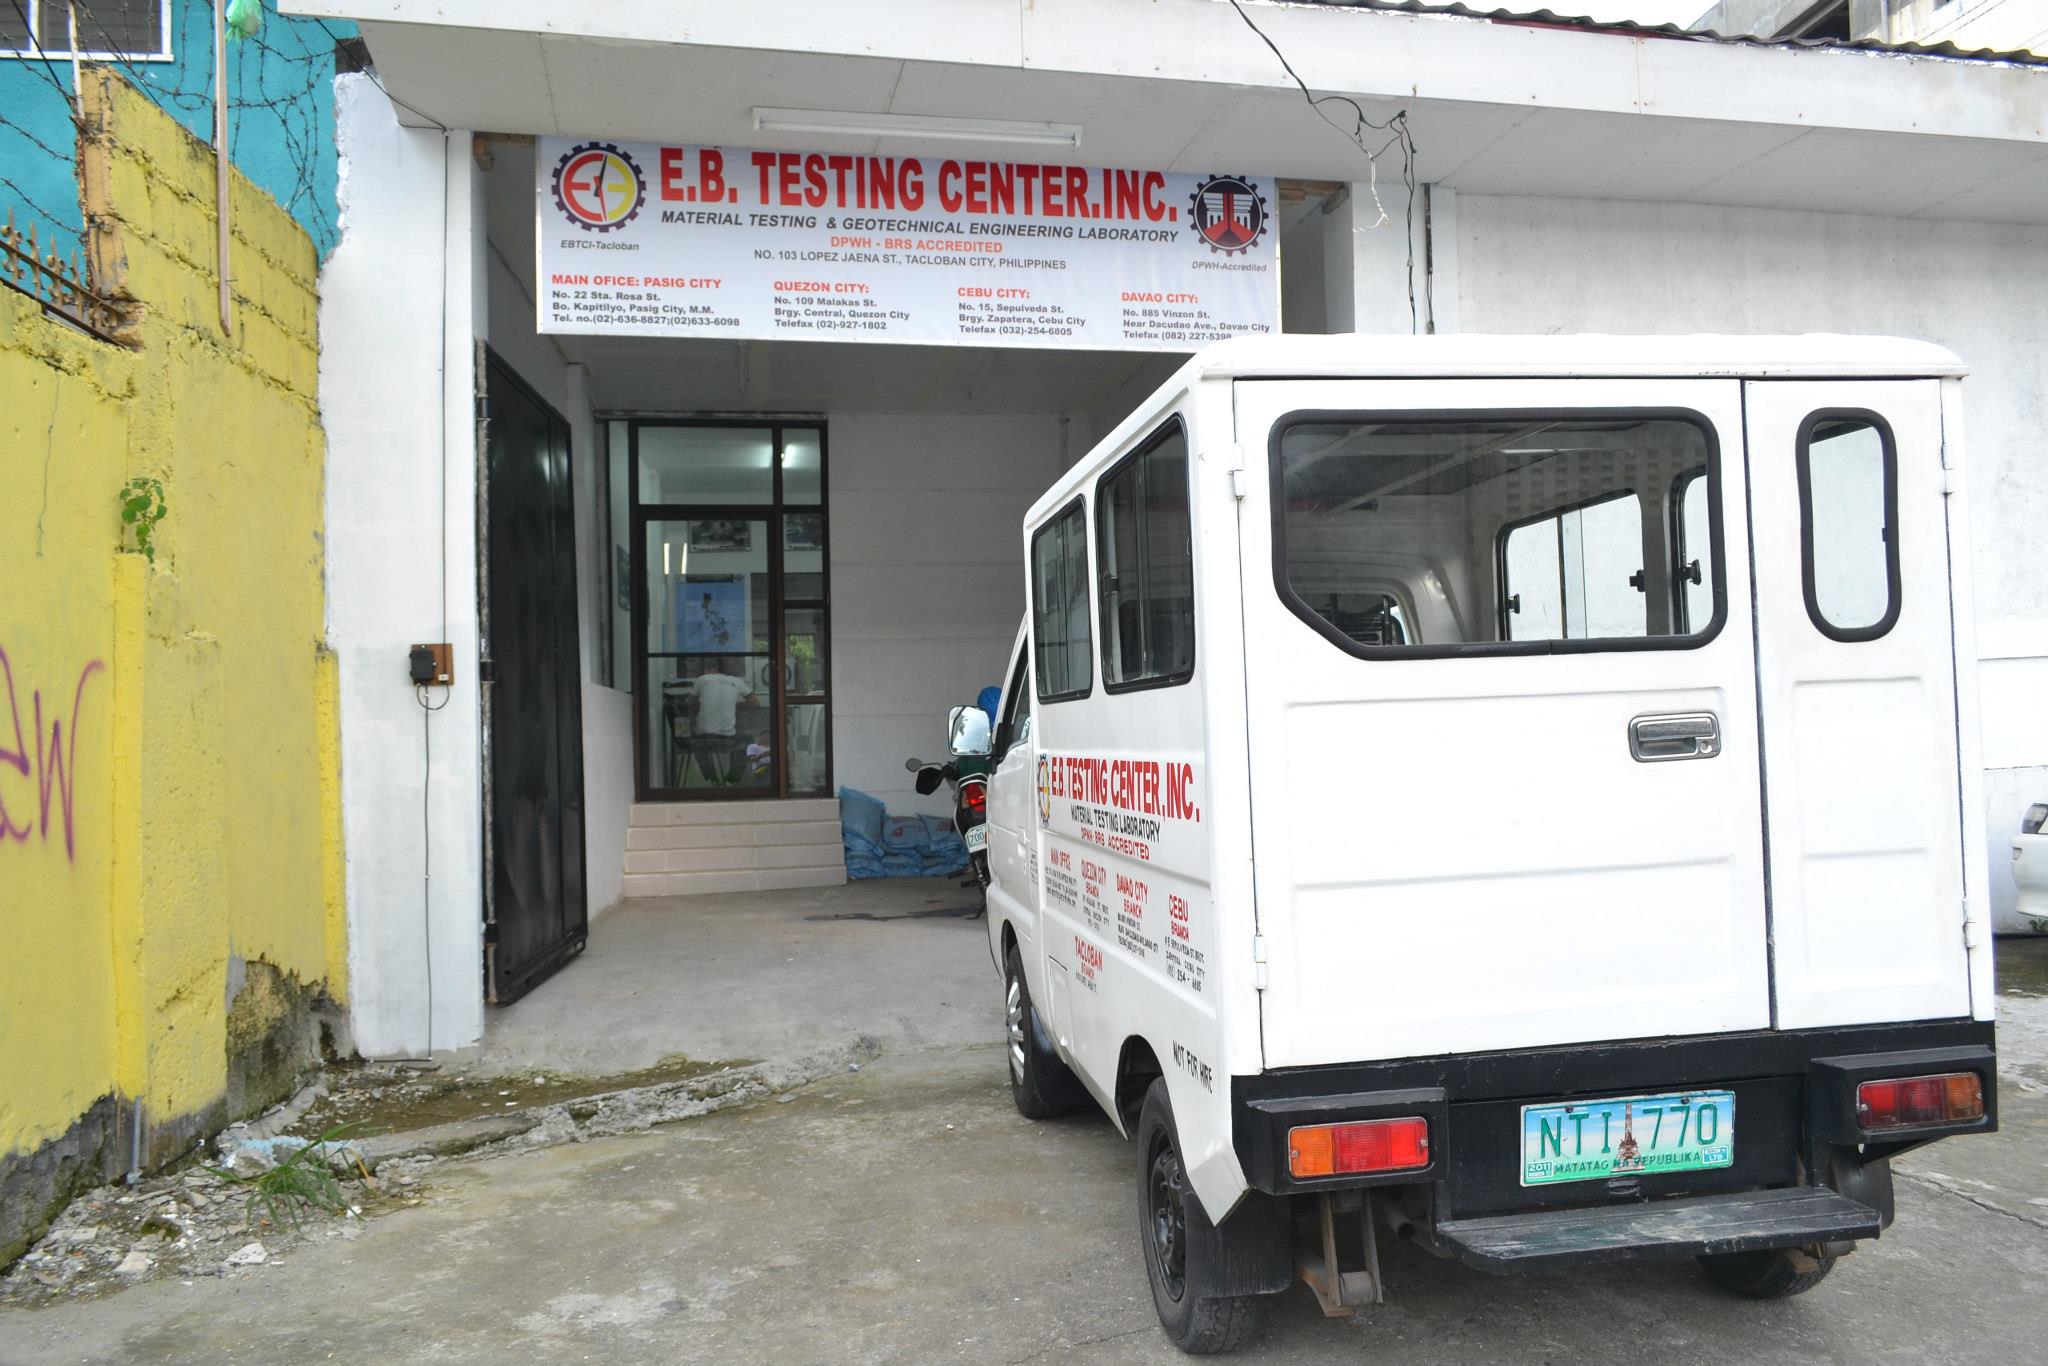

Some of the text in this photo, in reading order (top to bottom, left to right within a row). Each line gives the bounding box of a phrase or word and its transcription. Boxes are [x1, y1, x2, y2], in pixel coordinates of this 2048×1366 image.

[660, 147, 737, 203] E.B.
[752, 152, 924, 213] TESTING
[661, 211, 1178, 243] MATERIAL TESTING & GEOTECHNICAL ENGINEERING LABORATORY
[831, 236, 871, 248] DPWH
[885, 238, 912, 249] BRS
[917, 239, 1002, 252] ACCREDITED
[754, 250, 774, 259] NO.
[779, 251, 797, 260] 103
[801, 252, 838, 262] LOPEZ
[841, 252, 879, 263] JAENA
[906, 255, 966, 266] TACLOBAN
[969, 257, 996, 268] CITY,
[1000, 259, 1066, 270] PHILIPPINES
[1192, 261, 1267, 272] DPWH-Accredited
[552, 275, 722, 289] MAIN OFICE: PASIG CITY
[774, 281, 869, 293] QUEZON CITY:
[552, 291, 661, 301] No. 22 Sta. Rosa St.
[958, 287, 1030, 298] CEBU CITY:
[1121, 292, 1199, 303] DAVAO CITY:
[774, 296, 877, 307] No. 109 Malakas St.
[958, 303, 1064, 313] No. 15, Sepulveda St.
[552, 302, 570, 310] Bo.
[629, 305, 659, 314] Pasig
[662, 305, 686, 315] City,
[689, 306, 714, 314] M.M.
[774, 308, 910, 321] Brgy. Central, Quezon City
[1142, 309, 1159, 317] 885
[1162, 310, 1194, 318] Vinzon
[1197, 311, 1210, 319] St.
[553, 314, 573, 322] Tel.
[775, 319, 886, 330] Telefax (02)-927-1802
[959, 314, 1086, 326] Brgy. Zapatera, Cebu City
[960, 325, 995, 333] Telefax
[1123, 320, 1146, 328] Near
[1149, 320, 1190, 329] Dacudao
[1219, 323, 1248, 331] Davao
[1251, 324, 1270, 333] City
[1123, 331, 1158, 339] Telefax
[1162, 331, 1186, 341] (082)
[1066, 757, 1107, 806] TESTING
[1071, 804, 1161, 844] MATERIAL TESTING LABORATORY
[1108, 834, 1150, 861] ACCREDITED
[1135, 880, 1148, 904] CITY
[1169, 894, 1189, 922] CEBU
[1075, 936, 1102, 972] TACLOBAN
[1173, 1040, 1213, 1094] NOT FOR HIRE
[1541, 1103, 1718, 1158] NTI 770
[1529, 1163, 1551, 1172] 2011
[1554, 1160, 1609, 1174] MATATAG
